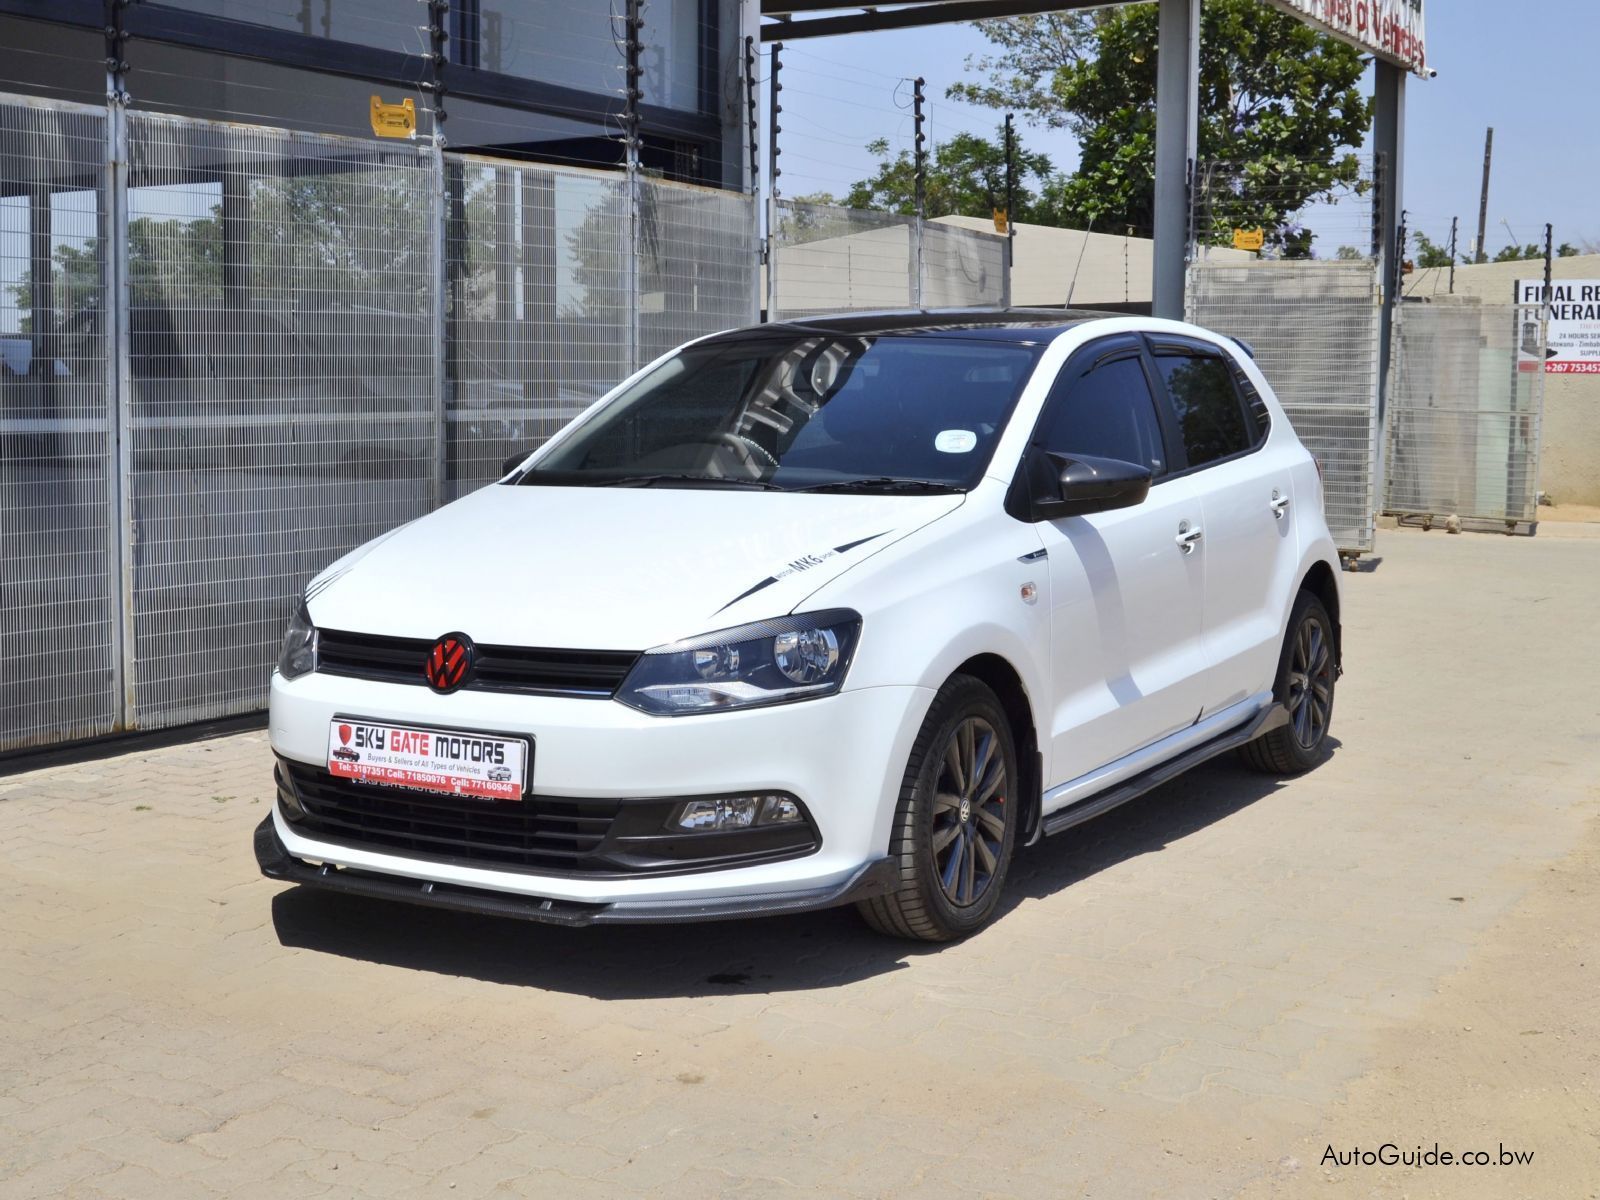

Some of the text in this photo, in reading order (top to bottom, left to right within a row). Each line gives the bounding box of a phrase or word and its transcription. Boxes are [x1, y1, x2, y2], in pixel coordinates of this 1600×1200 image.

[1545, 363, 1568, 372] +267
[788, 554, 824, 572] MK6
[355, 726, 505, 765] SKY GATE MOTORS
[367, 752, 387, 763] Buyers
[394, 756, 413, 766] Sellers
[414, 759, 421, 767] of
[431, 761, 447, 771] Types
[448, 763, 456, 771] of
[456, 764, 481, 775] Vehicles
[338, 762, 352, 772] Tel:
[387, 768, 405, 779] Cell:
[406, 771, 446, 785] 71850976
[451, 777, 470, 788] Cell:
[471, 780, 513, 793] 77160946
